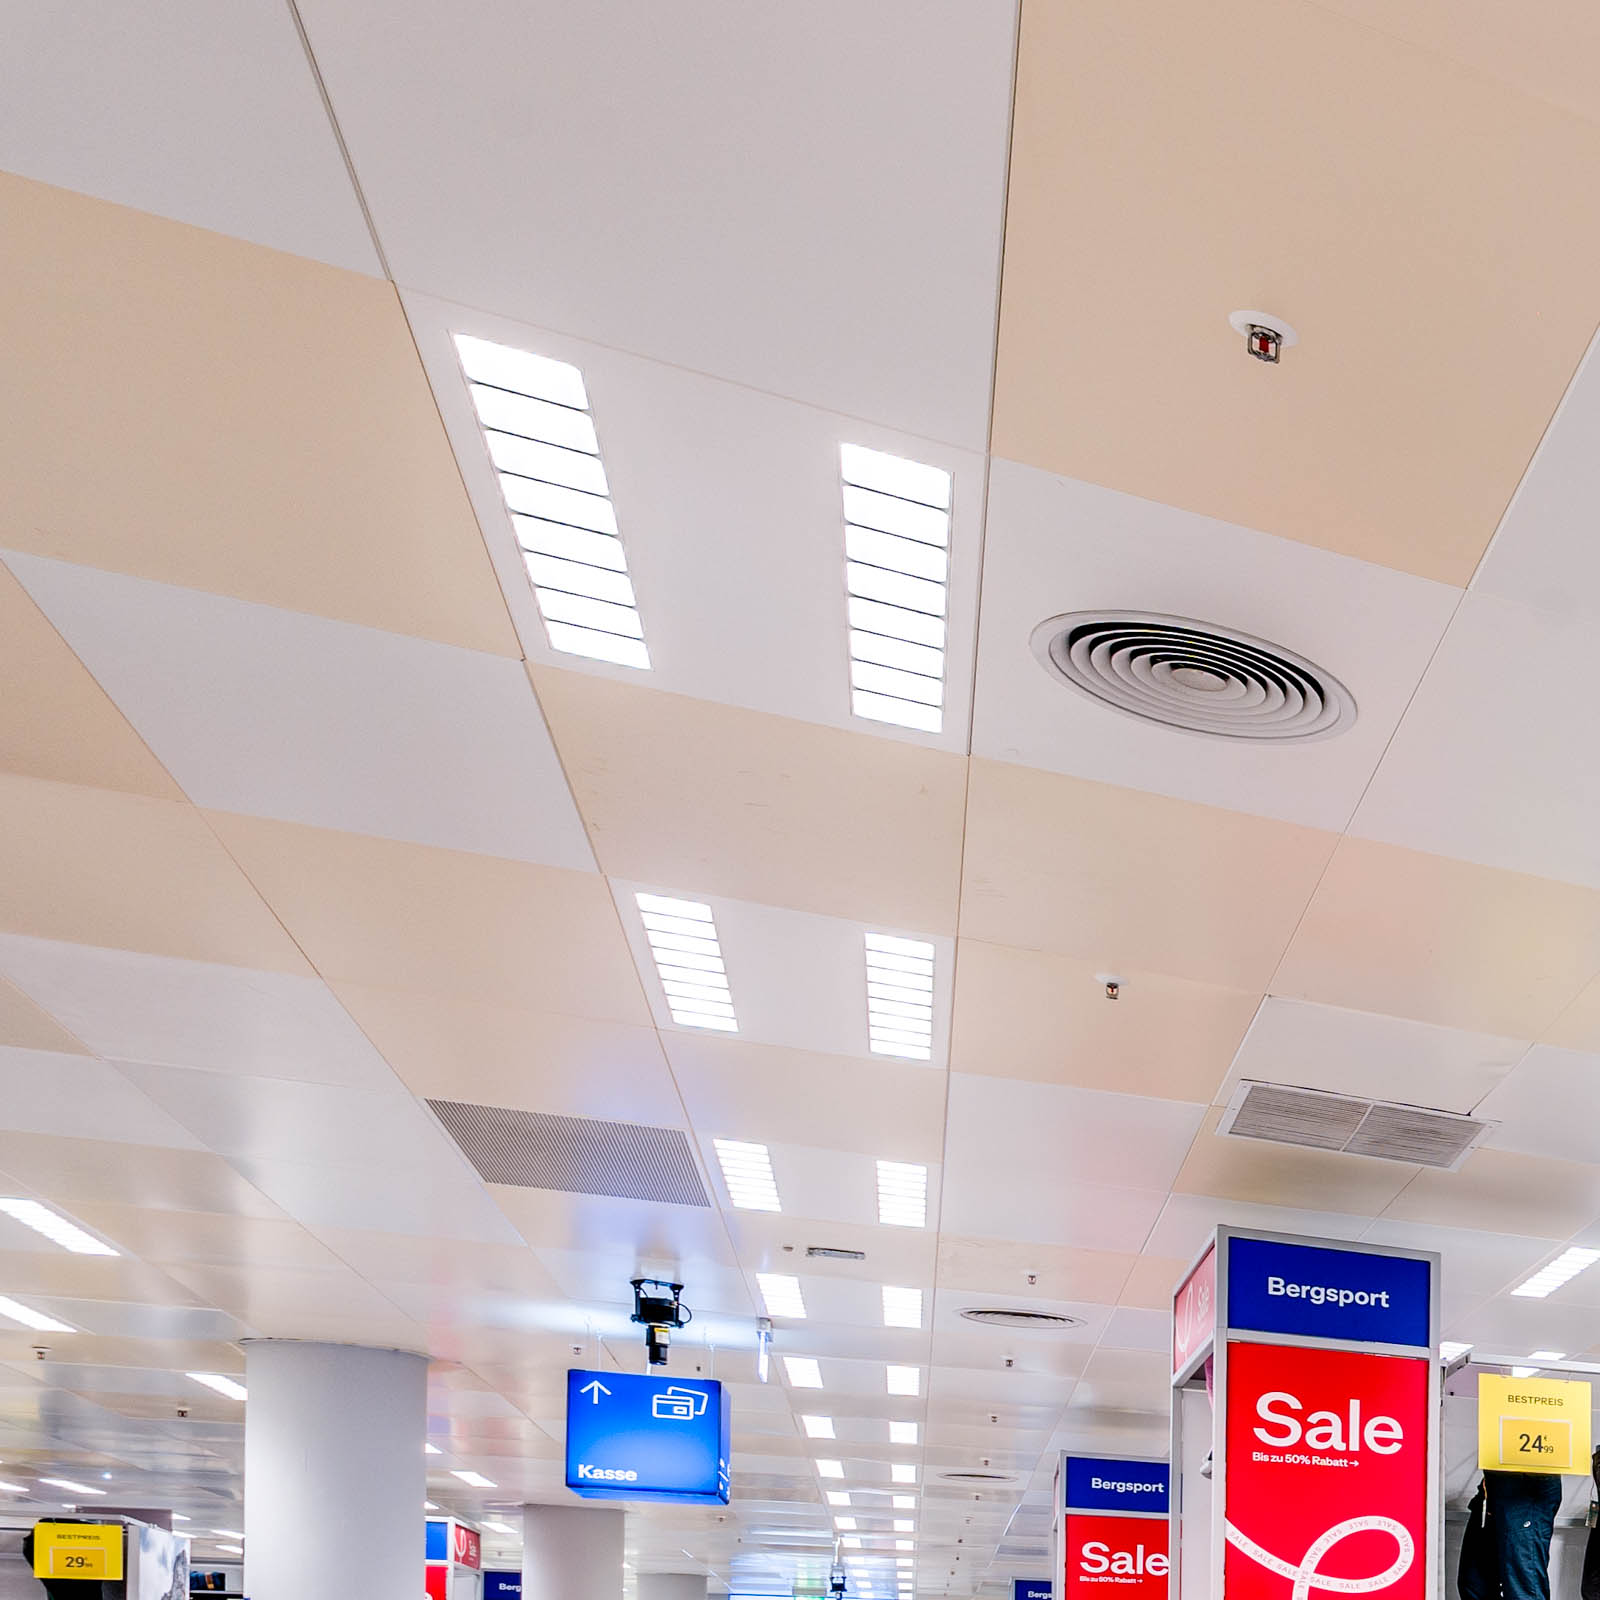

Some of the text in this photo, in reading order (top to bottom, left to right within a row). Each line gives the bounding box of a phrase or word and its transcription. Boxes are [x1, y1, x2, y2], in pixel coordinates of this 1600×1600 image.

[1268, 1276, 1389, 1308] Bergsport
[1508, 1394, 1564, 1407] BESTPREIS
[1253, 1392, 1404, 1455] Sale
[1252, 1452, 1348, 1468] Bis zu 50% Rabatt
[578, 1464, 638, 1481] Kasse
[1091, 1477, 1164, 1493] Bergsport
[1079, 1541, 1169, 1576] Sale
